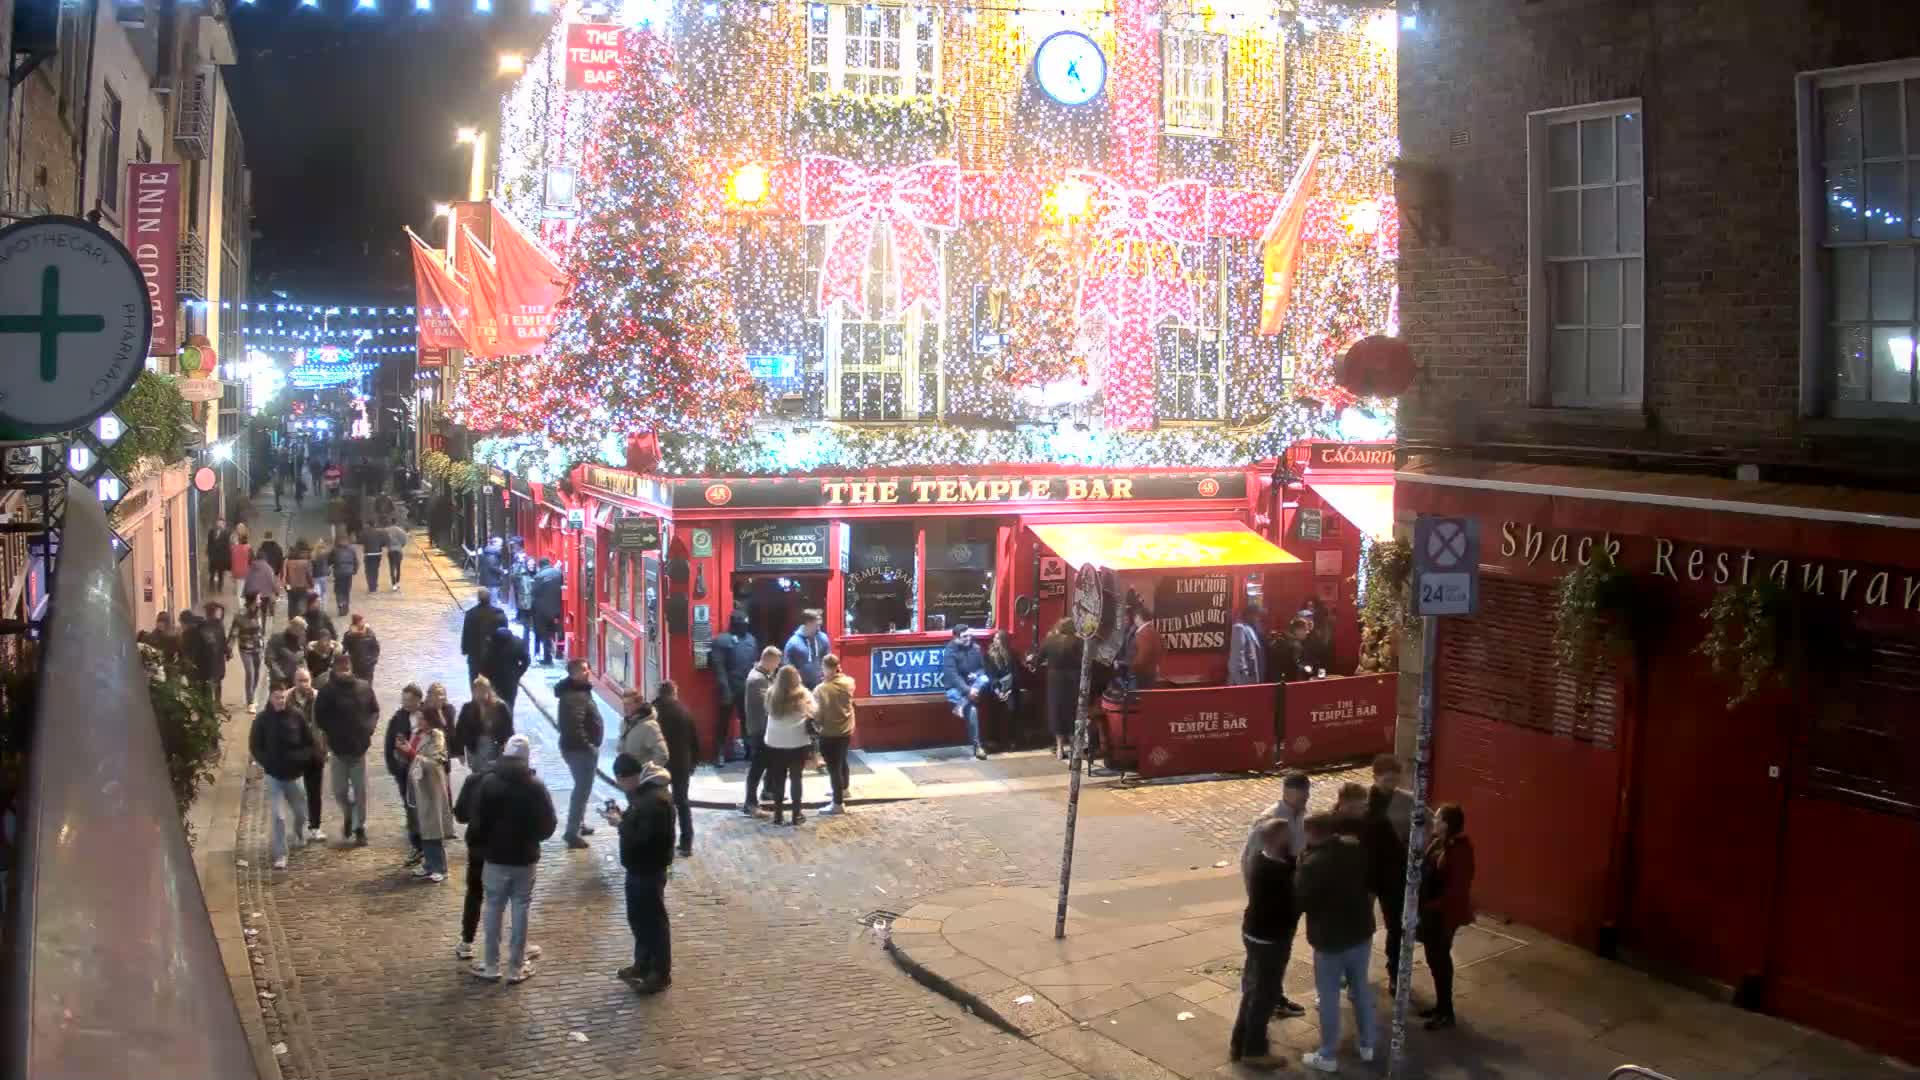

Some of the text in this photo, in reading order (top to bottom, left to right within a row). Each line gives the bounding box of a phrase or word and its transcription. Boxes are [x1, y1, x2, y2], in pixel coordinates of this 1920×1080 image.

[586, 29, 618, 46] THE
[569, 47, 622, 65] TEMPL
[138, 172, 169, 233] NINE
[520, 305, 545, 314] THE
[503, 314, 556, 326] TEMPL
[90, 303, 137, 402] PHARMACY
[823, 478, 1133, 504] THE TEMPLE BAR
[751, 539, 817, 562] TOBACCO
[1501, 521, 1621, 567] Shack
[1176, 578, 1226, 593] EMPEROR
[1423, 584, 1443, 602] 24
[1212, 593, 1226, 608] OF
[1152, 616, 1182, 632] LTED
[880, 648, 944, 668] POWE
[1337, 700, 1353, 708] THE
[1200, 712, 1219, 721] THE
[1310, 705, 1377, 722] TEMPLE BAR
[1168, 718, 1248, 733] TEMPLE BAR
